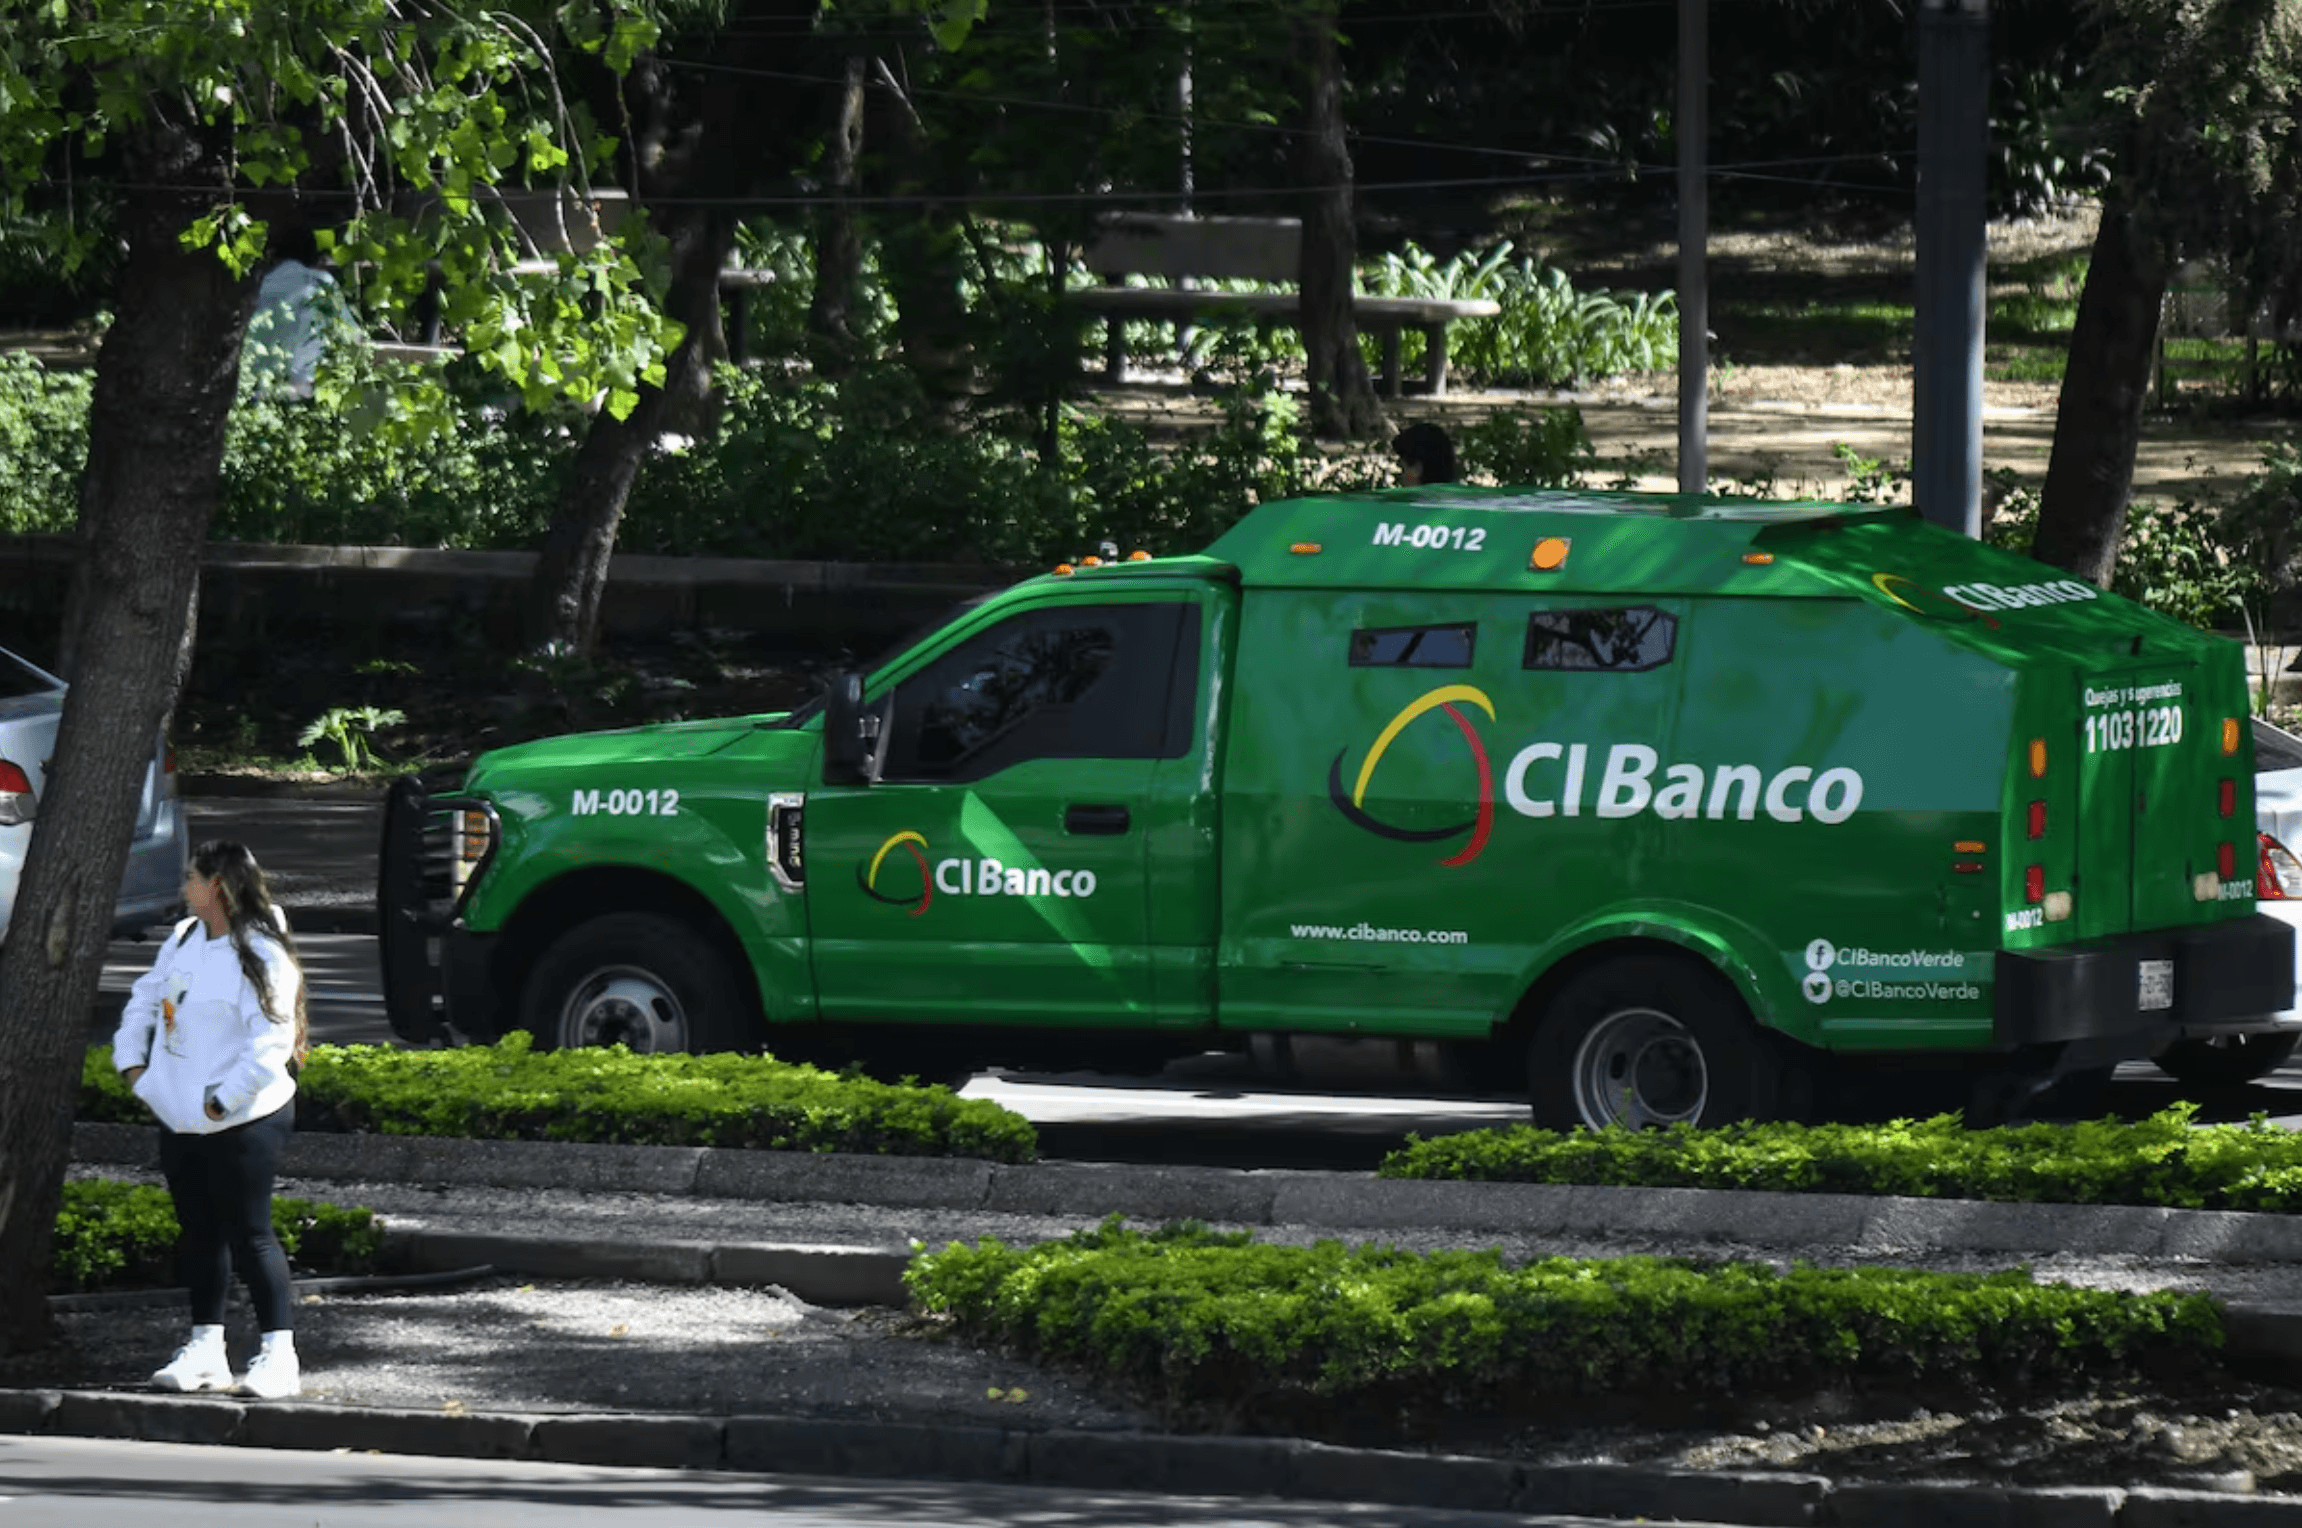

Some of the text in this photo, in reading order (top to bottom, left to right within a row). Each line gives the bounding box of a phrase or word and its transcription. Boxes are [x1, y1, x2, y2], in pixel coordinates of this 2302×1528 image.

[1372, 522, 1487, 552] M-0012
[571, 789, 680, 817] M-0012
[1290, 922, 1469, 944] www.cibanco.com
[1837, 948, 1965, 967] CIBancoVerde
[1835, 979, 1981, 1000] @CIBancoVerde
